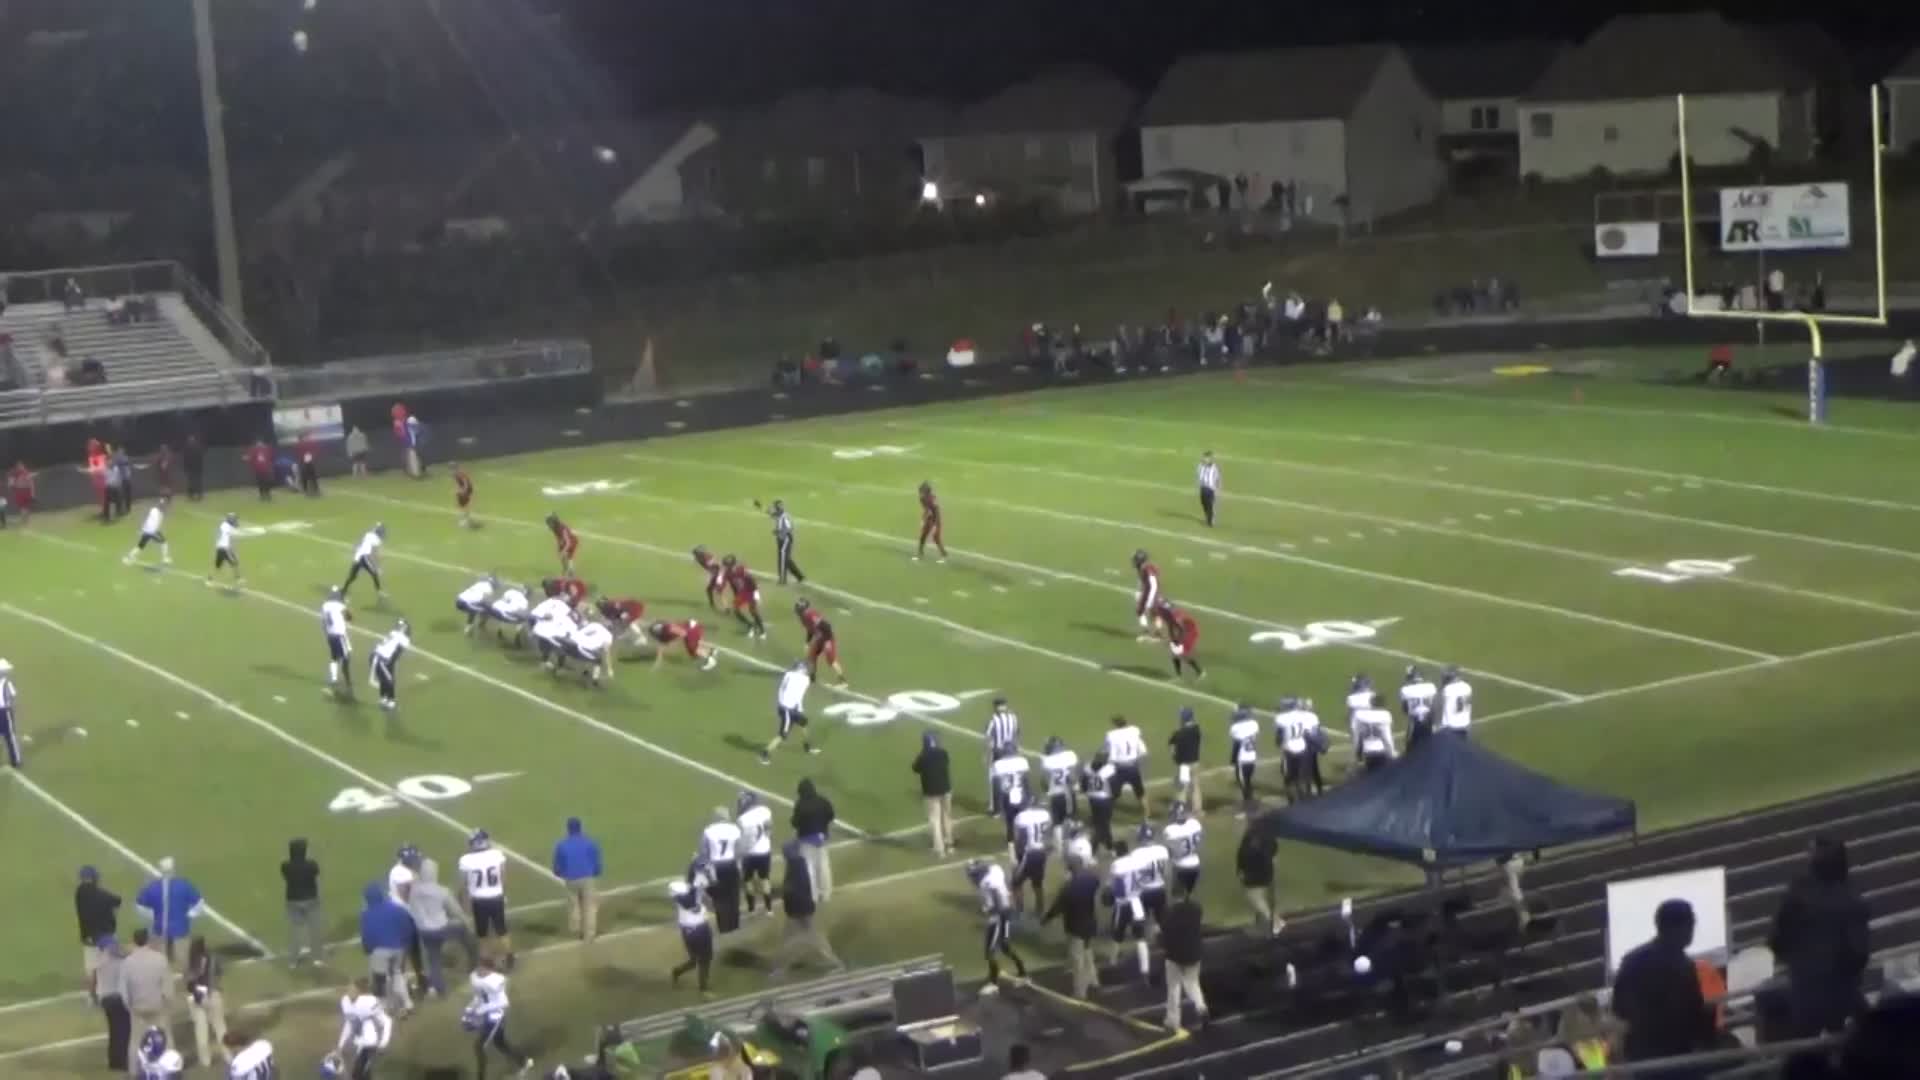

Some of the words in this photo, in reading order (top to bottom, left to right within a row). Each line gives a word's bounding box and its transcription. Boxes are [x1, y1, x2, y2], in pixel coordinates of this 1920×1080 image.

[1611, 558, 1736, 583] 10
[1249, 620, 1377, 651] 20
[823, 690, 961, 726] 30
[328, 773, 473, 813] 40
[718, 839, 728, 856] 7
[471, 867, 498, 887] 76
